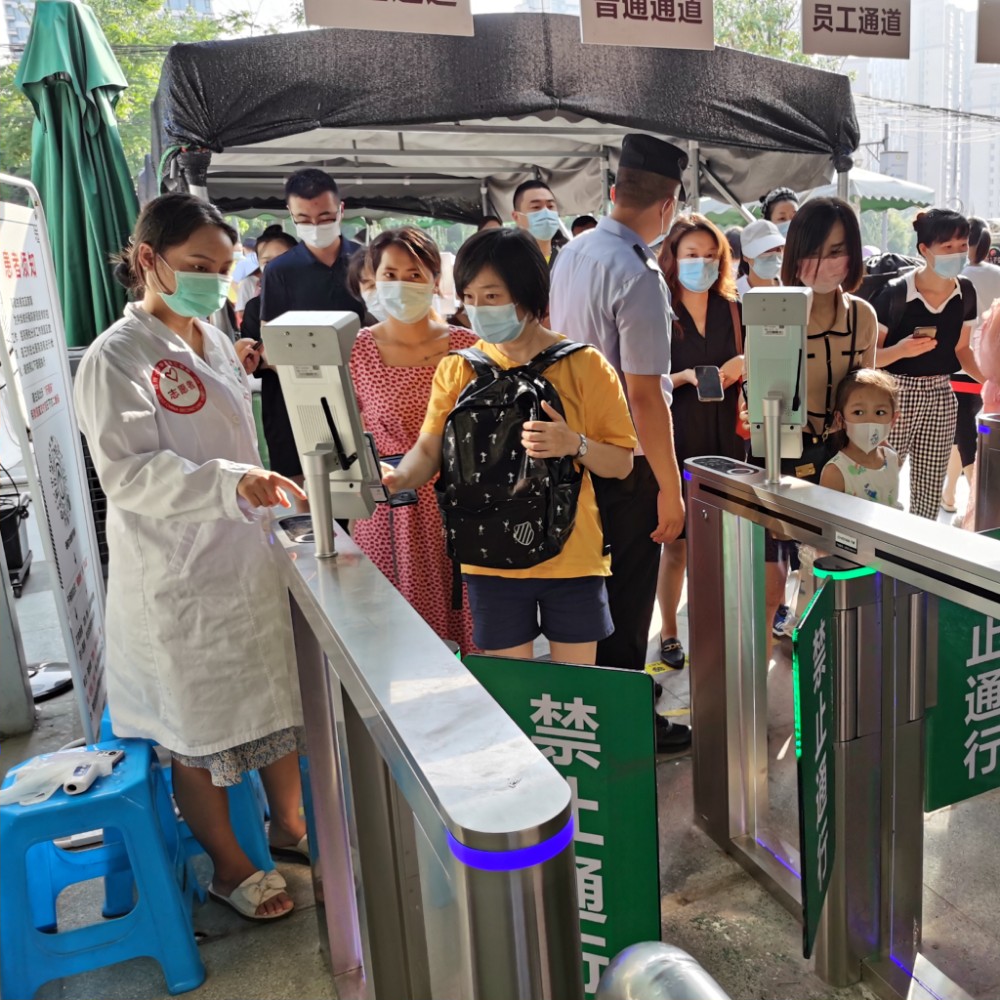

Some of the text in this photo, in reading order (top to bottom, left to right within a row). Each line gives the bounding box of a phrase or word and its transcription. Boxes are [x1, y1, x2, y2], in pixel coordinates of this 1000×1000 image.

[813, 4, 901, 36] 员工通道
[812, 618, 829, 892] 禁止通行
